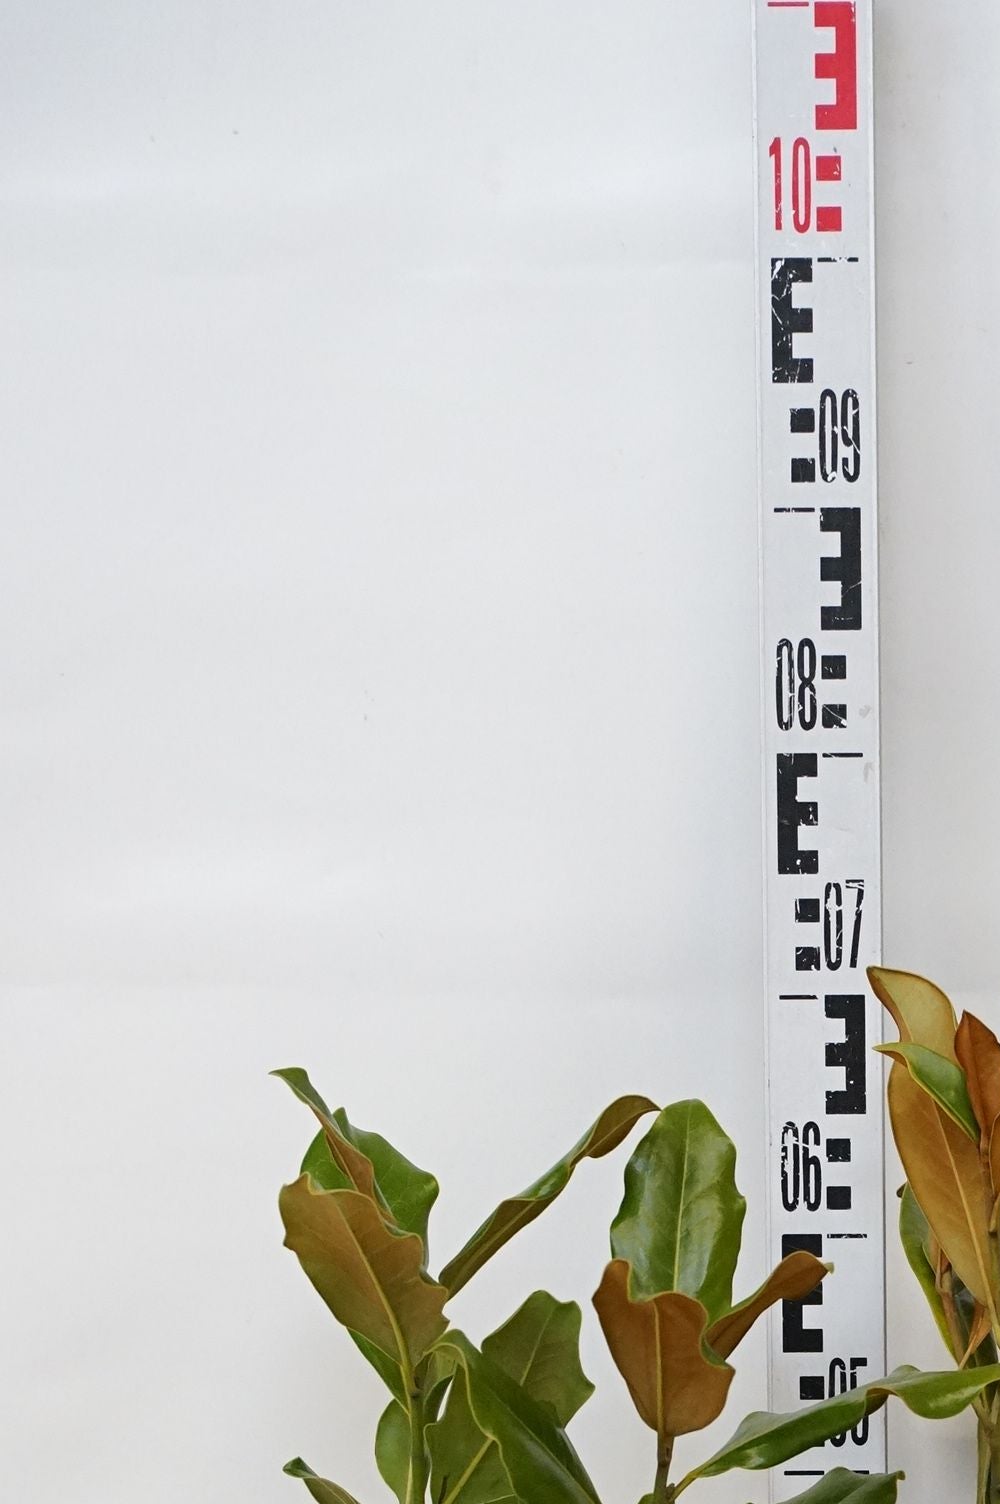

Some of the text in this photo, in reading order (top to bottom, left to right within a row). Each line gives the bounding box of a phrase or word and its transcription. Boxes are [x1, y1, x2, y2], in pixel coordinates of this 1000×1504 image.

[769, 137, 812, 233] 10
[819, 389, 861, 484] 09
[776, 637, 817, 732] 08
[824, 879, 865, 971] 07
[780, 1121, 821, 1212] 06
